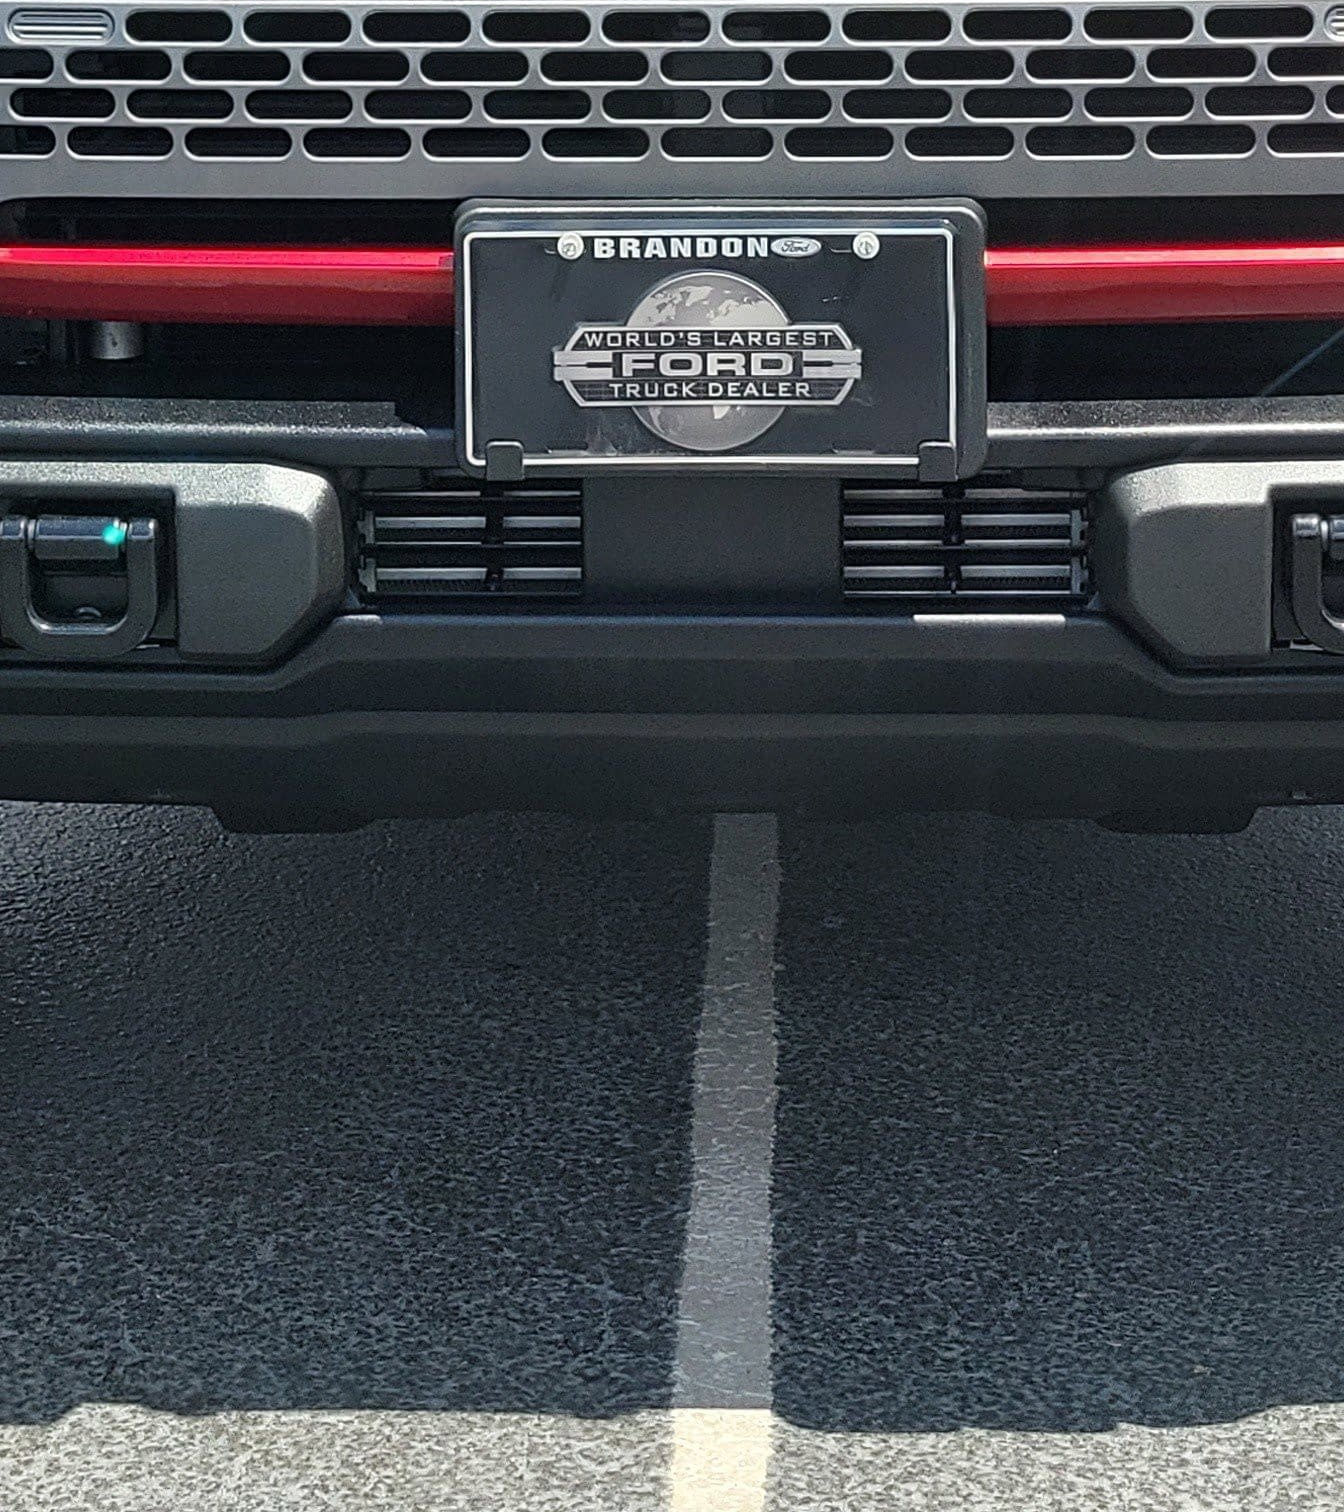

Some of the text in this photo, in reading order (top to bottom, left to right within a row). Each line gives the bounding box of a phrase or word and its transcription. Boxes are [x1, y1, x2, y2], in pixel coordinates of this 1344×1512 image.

[593, 236, 768, 258] BRANDON
[584, 331, 834, 347] WORLD'S LARGEST
[621, 351, 794, 377] FORD
[608, 381, 812, 398] TRUCK DEALER
